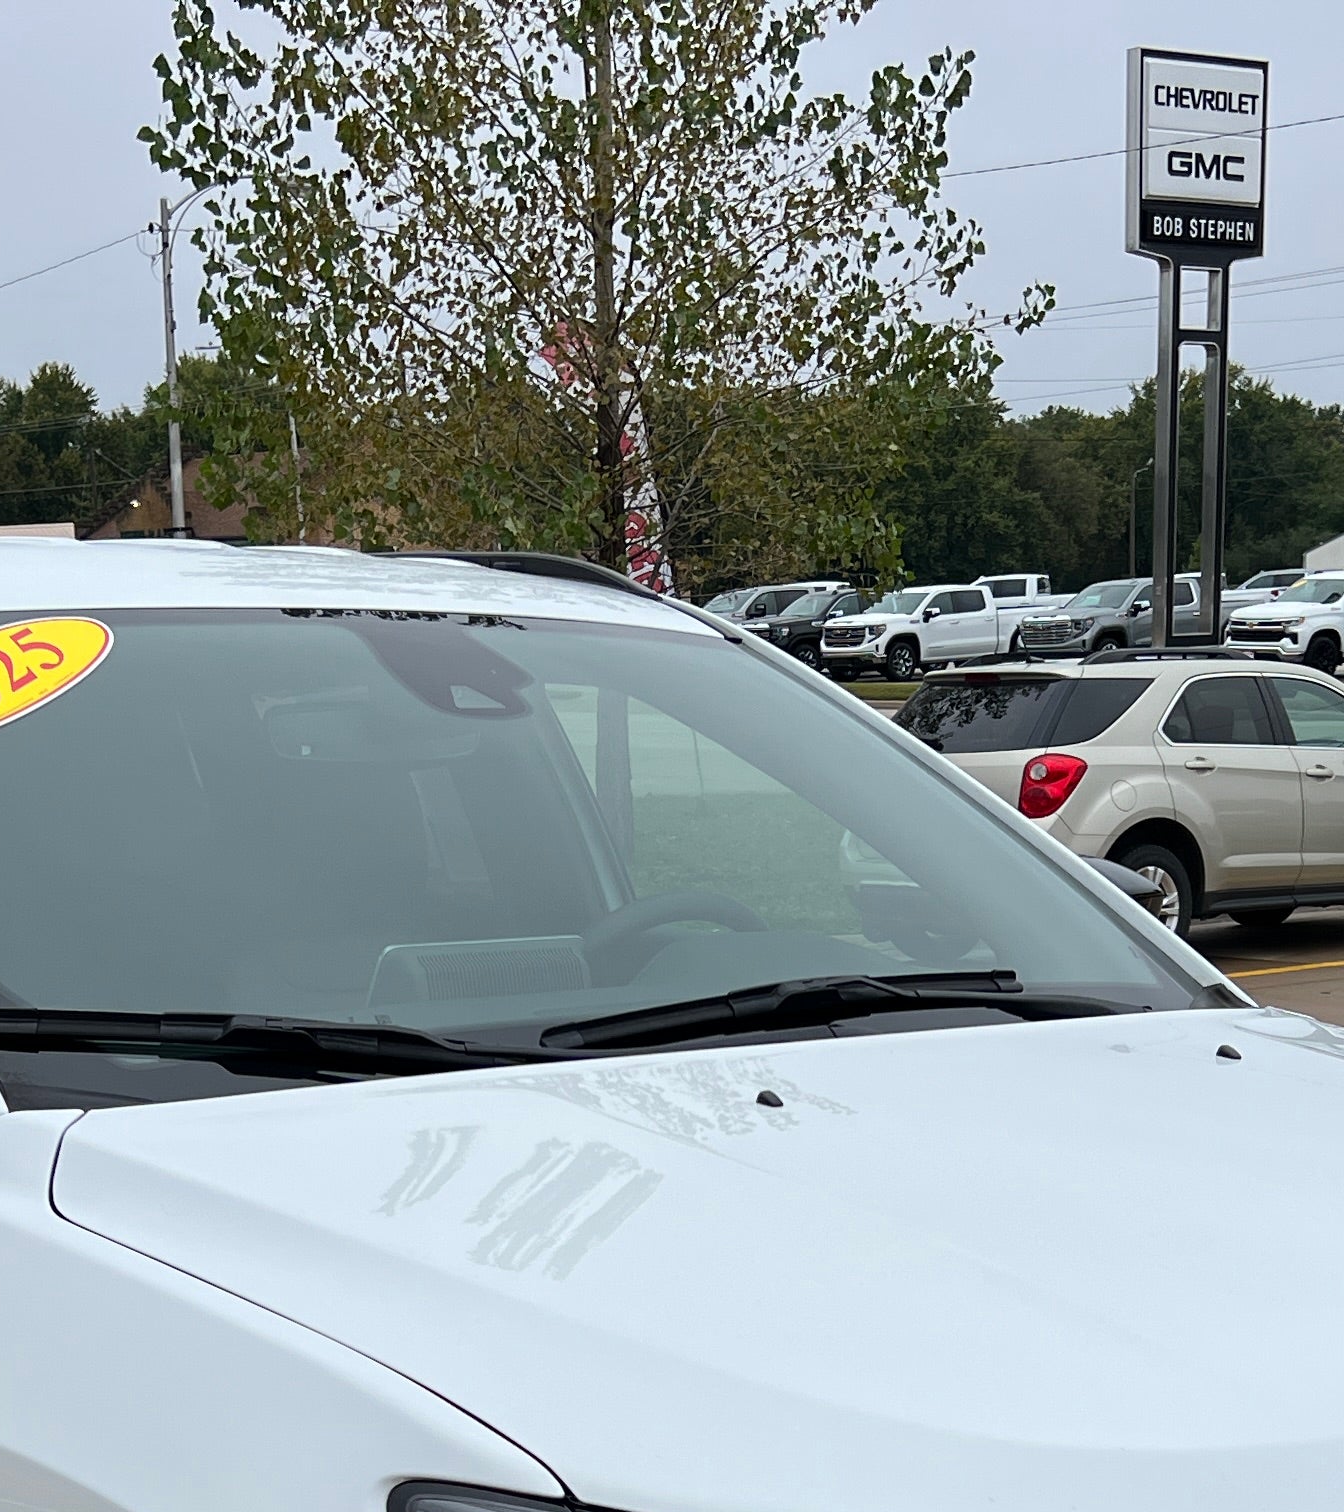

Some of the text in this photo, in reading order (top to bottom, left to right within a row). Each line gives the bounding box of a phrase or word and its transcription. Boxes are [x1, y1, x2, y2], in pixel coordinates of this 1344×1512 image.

[1154, 84, 1260, 116] CHEVROLET
[1167, 151, 1245, 182] GMC
[1153, 216, 1255, 242] BOB STEPHEN
